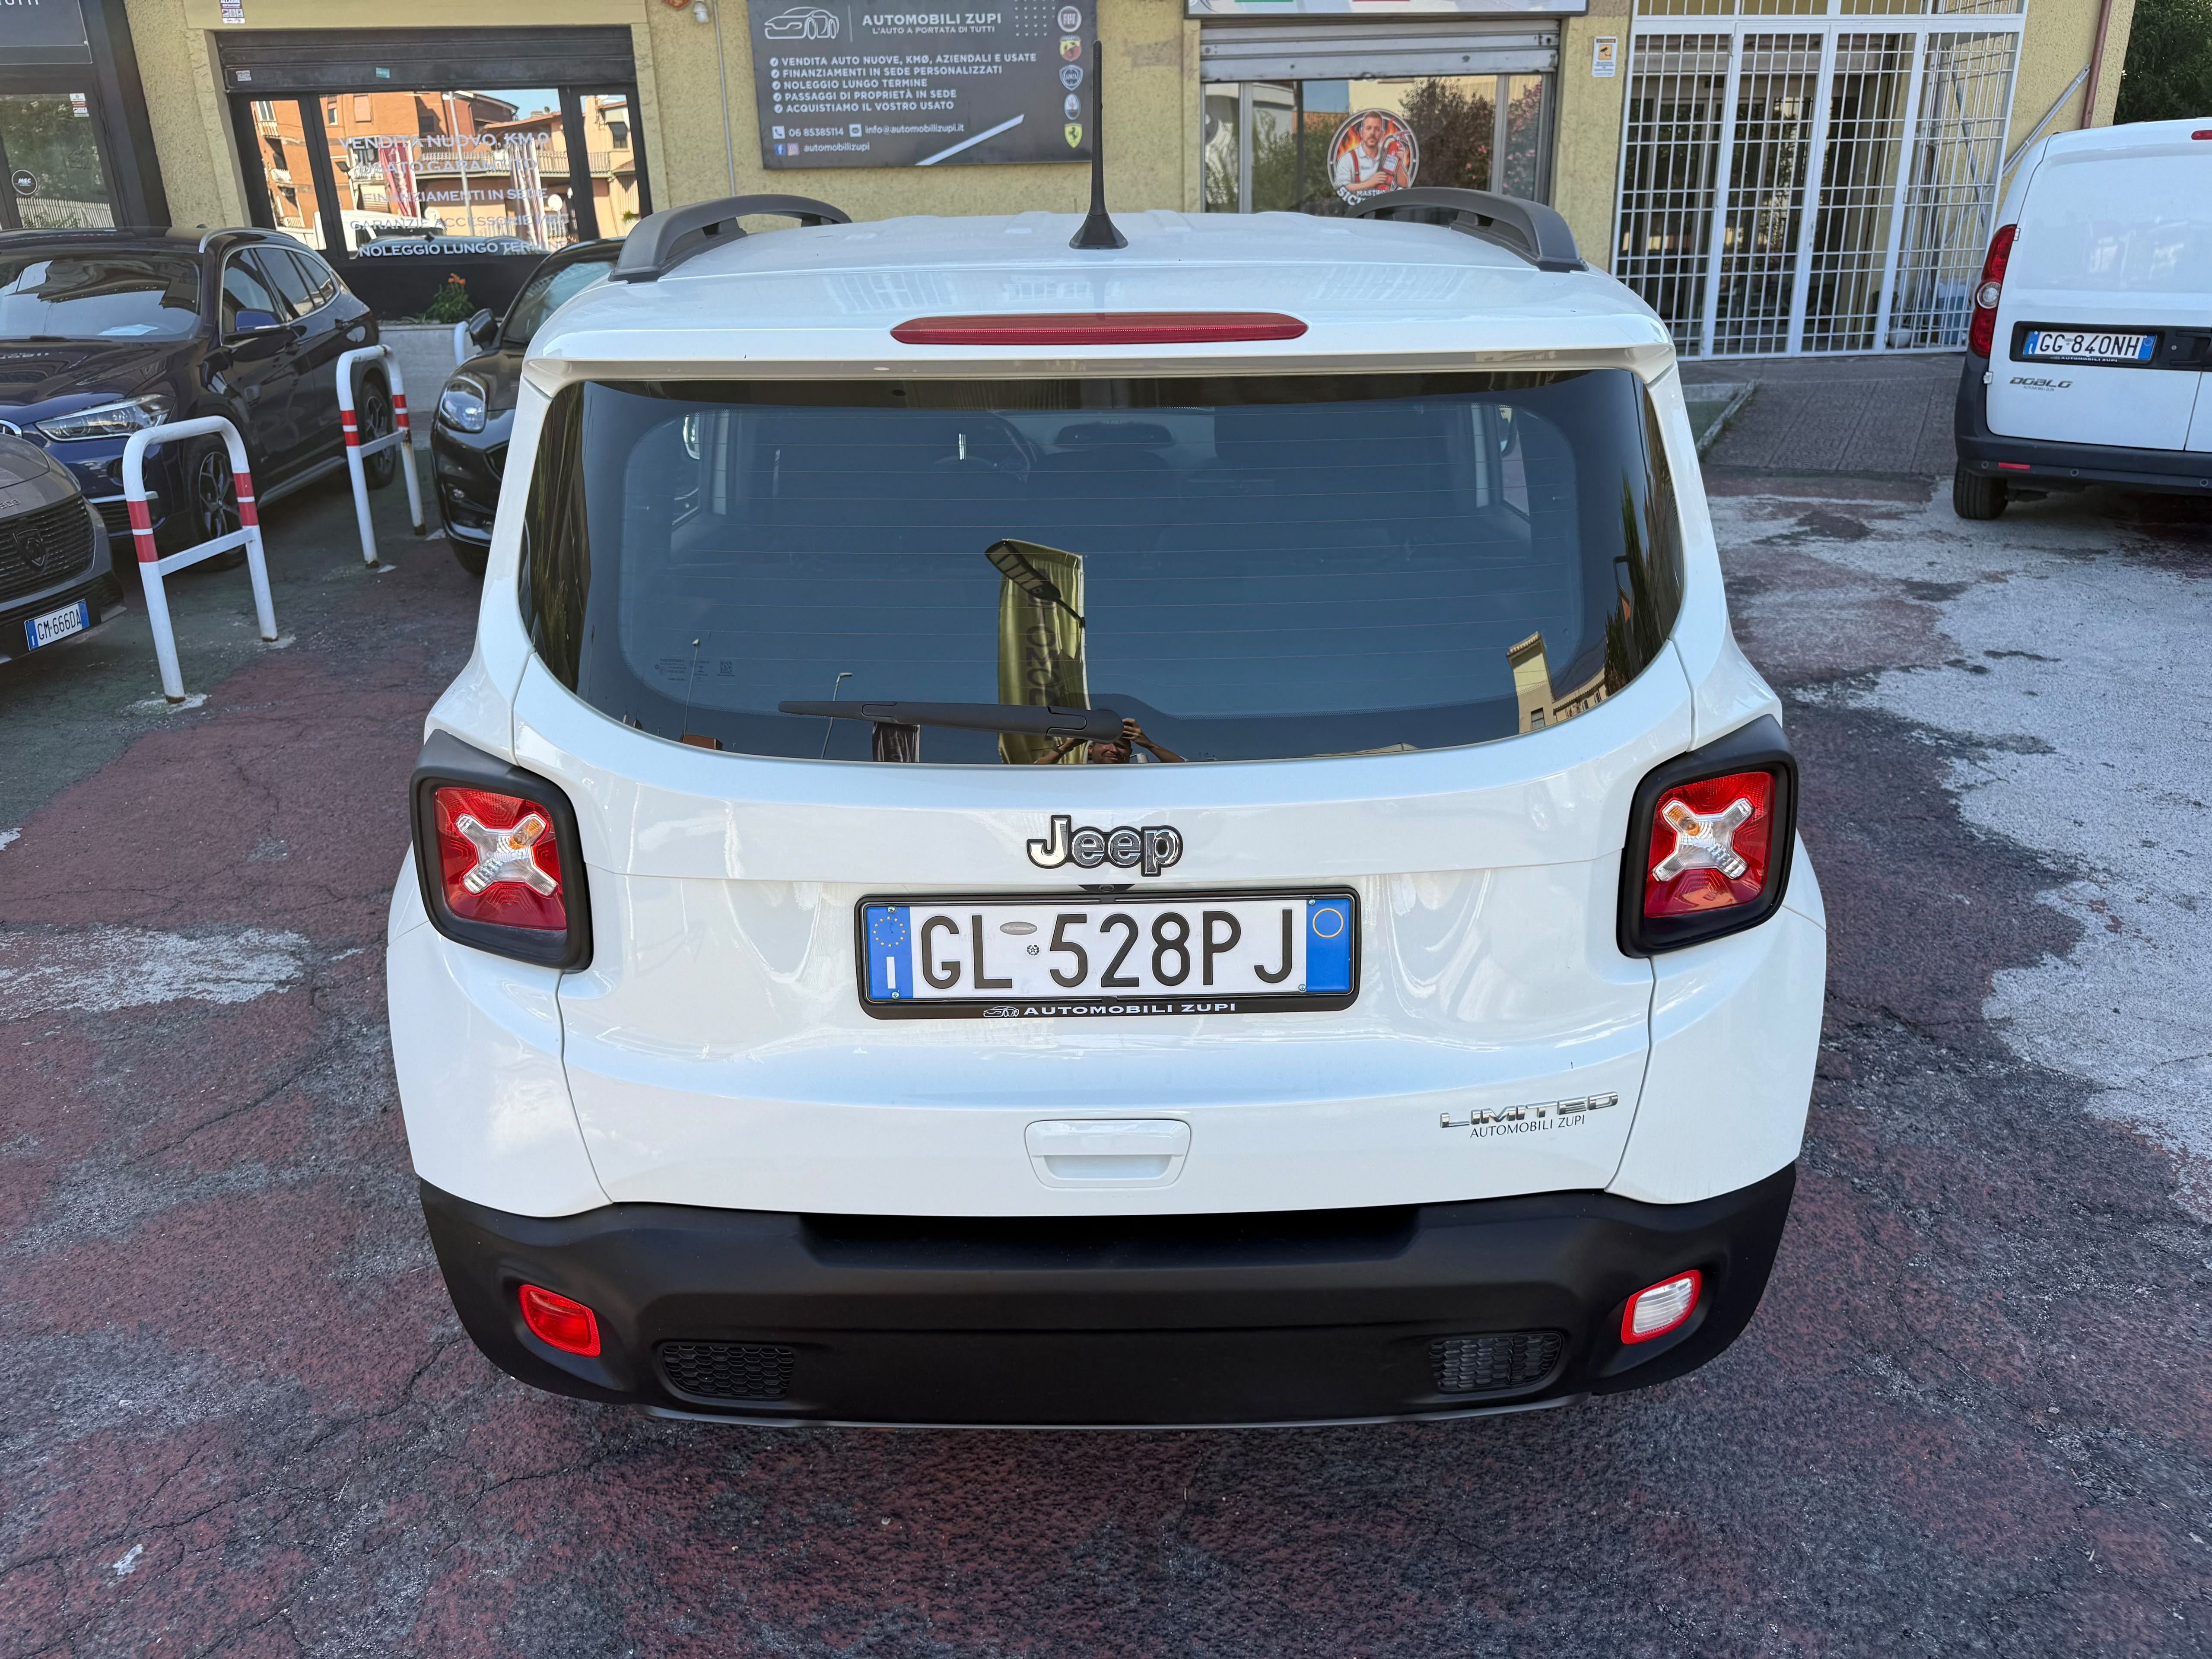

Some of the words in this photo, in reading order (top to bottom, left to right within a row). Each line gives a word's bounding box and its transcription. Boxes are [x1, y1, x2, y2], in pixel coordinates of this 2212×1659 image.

[862, 13, 960, 25] AUTOMOBILI
[965, 13, 1001, 24] ZUPI
[781, 57, 828, 66] VENDITA
[831, 56, 860, 65] AUTO
[863, 55, 903, 65] NUOVE,
[935, 54, 991, 63] AZIENDALI
[995, 54, 1001, 62] E
[1004, 53, 1037, 62] USATE
[783, 67, 866, 77] FINANZIAMENTI
[869, 67, 880, 76] IN
[884, 67, 911, 76] SEDE
[914, 65, 1002, 75] PERSONALIZZATI
[783, 79, 839, 89] NOLEGGIO
[842, 79, 879, 89] LUNGO
[882, 78, 928, 87] TERMINE
[785, 92, 836, 101] PASSAGGI
[839, 91, 851, 100] DI
[854, 89, 912, 100] PROPRIETÀ
[916, 90, 927, 99] IN
[930, 89, 957, 98] SEDE
[786, 103, 859, 113] ACQUISTIAMO
[862, 102, 871, 111] IL
[874, 102, 917, 111] VOSTRO
[920, 101, 954, 110] USATO
[788, 129, 801, 137] 06
[803, 128, 844, 137] 85385114
[864, 123, 964, 135] info@automobilizupi.it
[338, 135, 423, 150] VENDITA
[427, 133, 501, 148] NUOVO,
[505, 132, 533, 145] KM
[804, 142, 870, 153] automobilizupi
[360, 161, 424, 174] USATO
[429, 158, 537, 172] GARANTITO
[363, 190, 485, 202] FINANZIAMENTI
[488, 189, 504, 200] IN
[507, 188, 548, 200] SEDE
[350, 219, 430, 230] GARANZIE
[435, 216, 533, 228] ACCESSORIE
[359, 244, 440, 257] NOLEGGIO
[444, 242, 498, 255] LUNGO
[1027, 815, 1183, 877] Jeep
[1024, 1004, 1173, 1016] AUTOMOBILI
[1181, 1003, 1236, 1013] ZUPI
[1440, 1091, 1618, 1128] LIMITED
[1470, 1119, 1553, 1138] AUTOMOBILI
[1558, 1114, 1585, 1128] ZUPI
